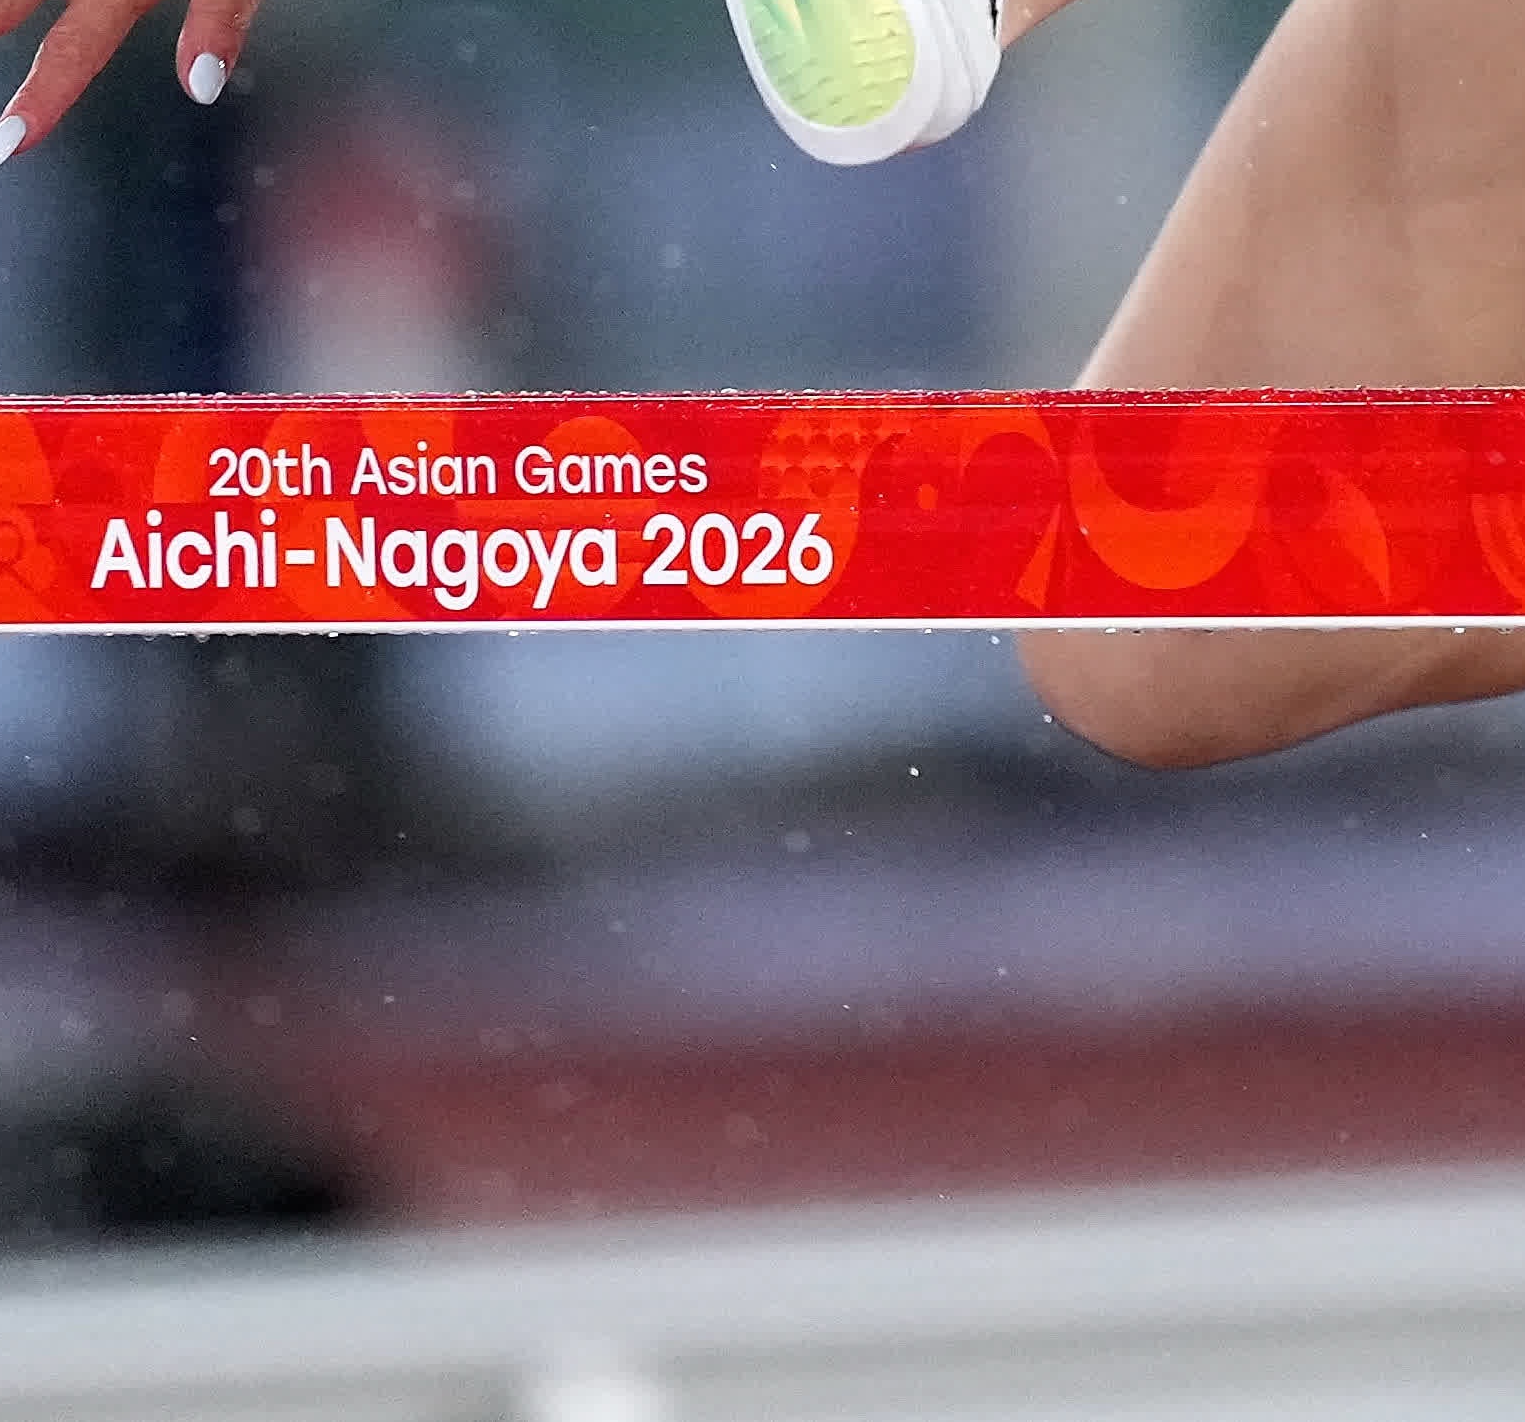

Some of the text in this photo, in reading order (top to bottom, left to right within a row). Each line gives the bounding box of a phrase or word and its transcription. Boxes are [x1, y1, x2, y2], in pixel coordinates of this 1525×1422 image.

[208, 441, 709, 497] 20th Asian Games
[90, 508, 833, 611] Aichi-Nagoya 2026
